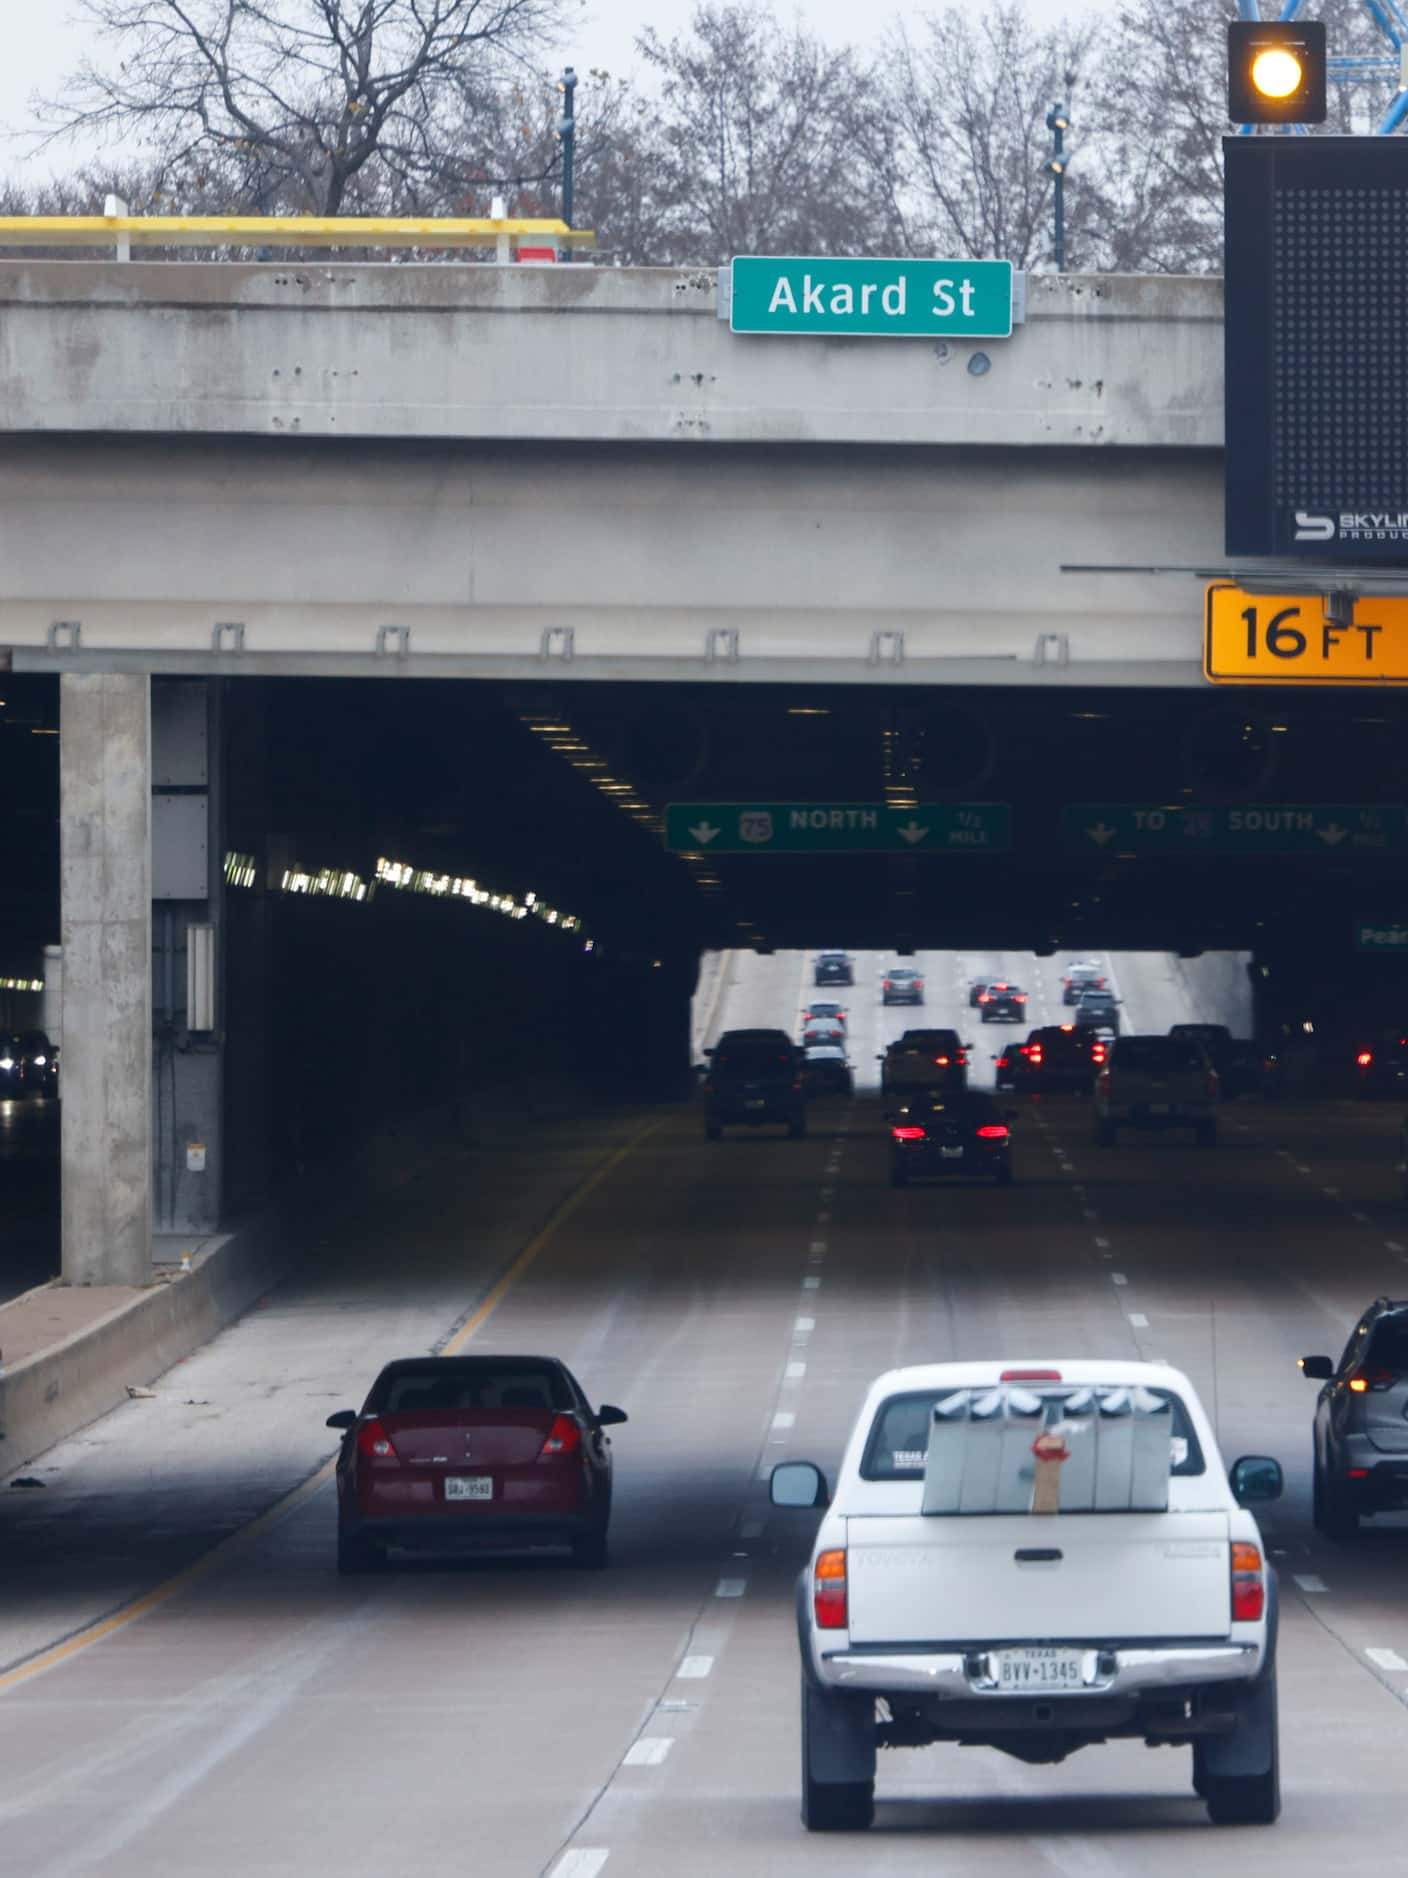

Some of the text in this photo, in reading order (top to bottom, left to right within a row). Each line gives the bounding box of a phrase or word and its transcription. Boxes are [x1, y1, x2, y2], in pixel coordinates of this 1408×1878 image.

[768, 274, 976, 317] Akard St
[790, 810, 879, 831] NORTH
[1132, 811, 1166, 832] TO
[1228, 810, 1314, 832] SOUTH
